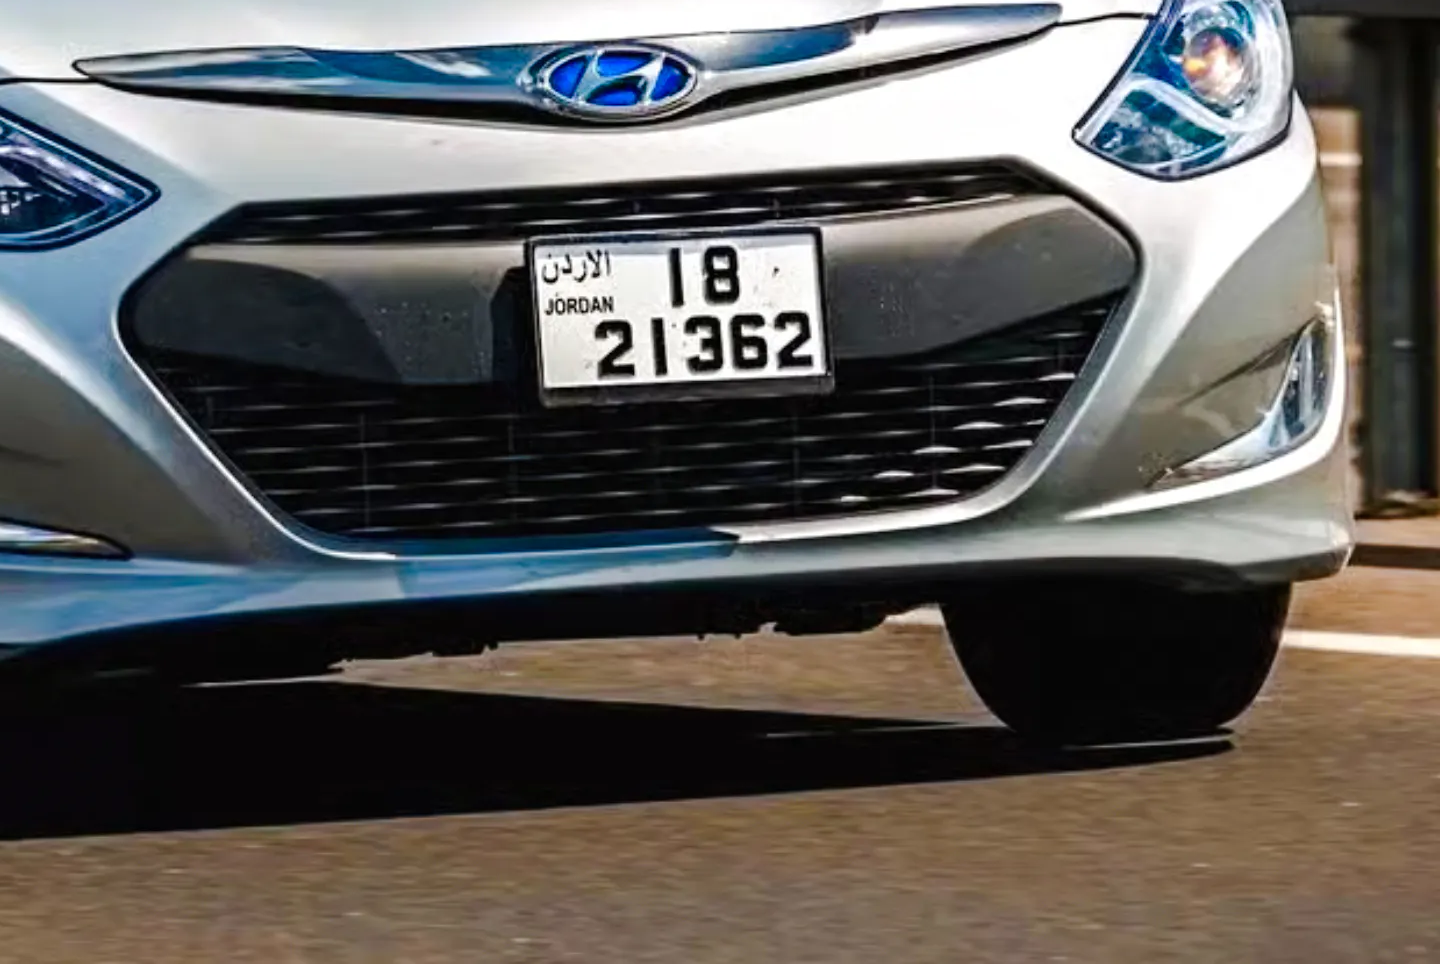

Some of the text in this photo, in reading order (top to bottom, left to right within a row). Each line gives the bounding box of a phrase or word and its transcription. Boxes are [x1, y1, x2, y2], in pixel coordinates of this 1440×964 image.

[544, 296, 614, 316] JORDAN
[668, 245, 741, 308] 18
[593, 311, 814, 379] 21362
